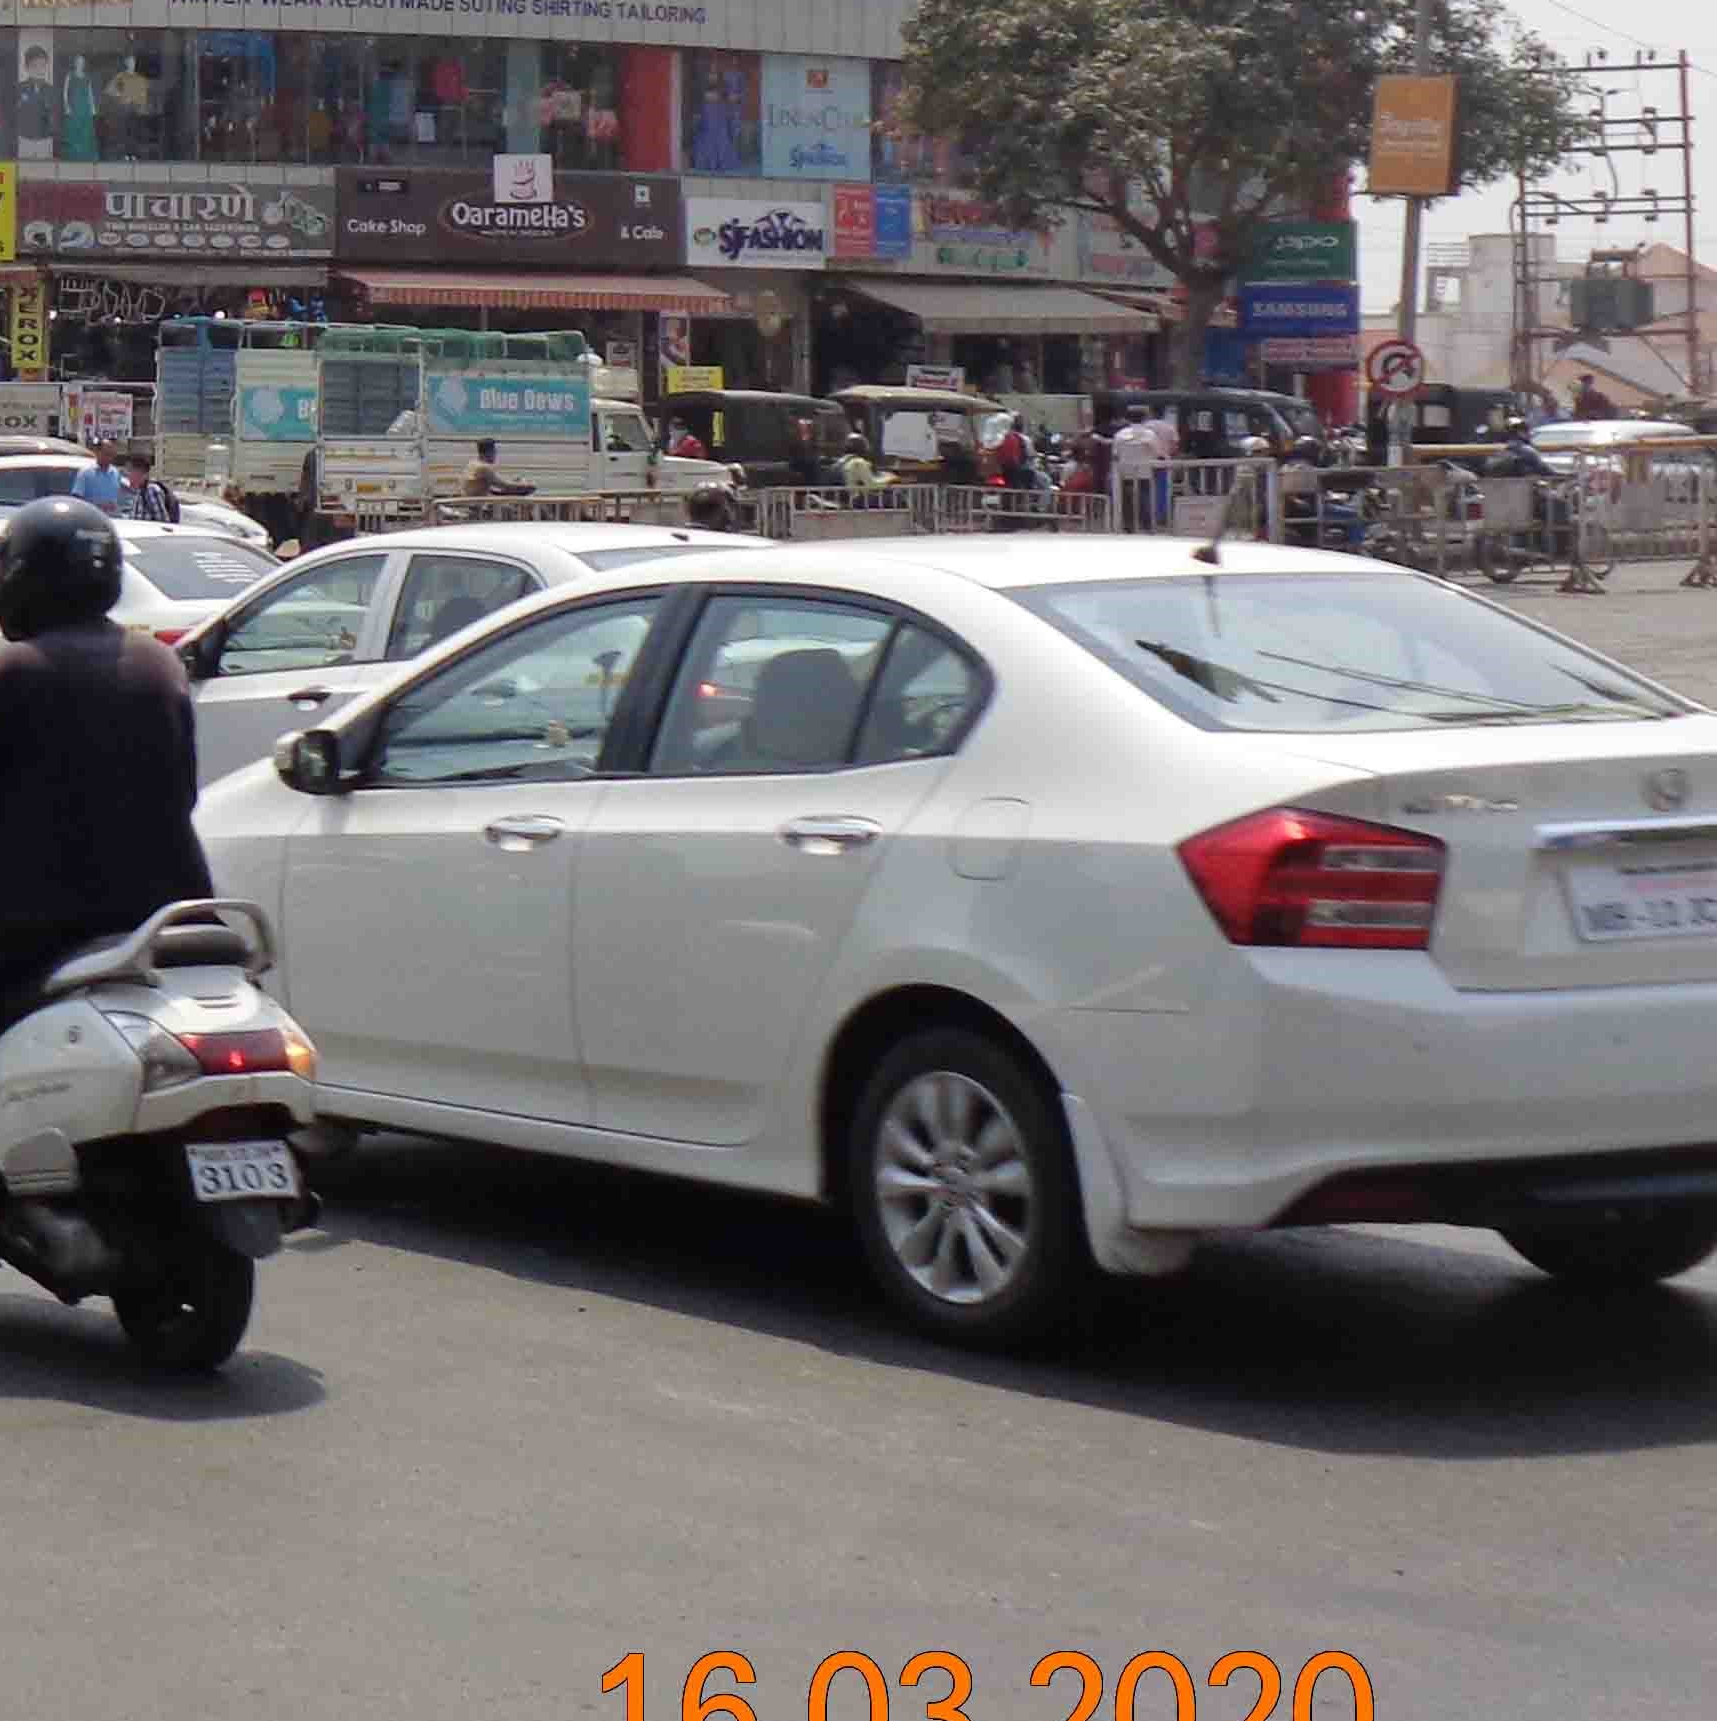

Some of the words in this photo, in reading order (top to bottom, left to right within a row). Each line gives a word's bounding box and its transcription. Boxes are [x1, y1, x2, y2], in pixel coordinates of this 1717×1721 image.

[617, 3, 706, 25] TAILORING
[347, 218, 387, 233] Cake
[390, 219, 426, 236] Shop
[479, 389, 518, 411] Blue
[199, 1162, 288, 1194] 3103
